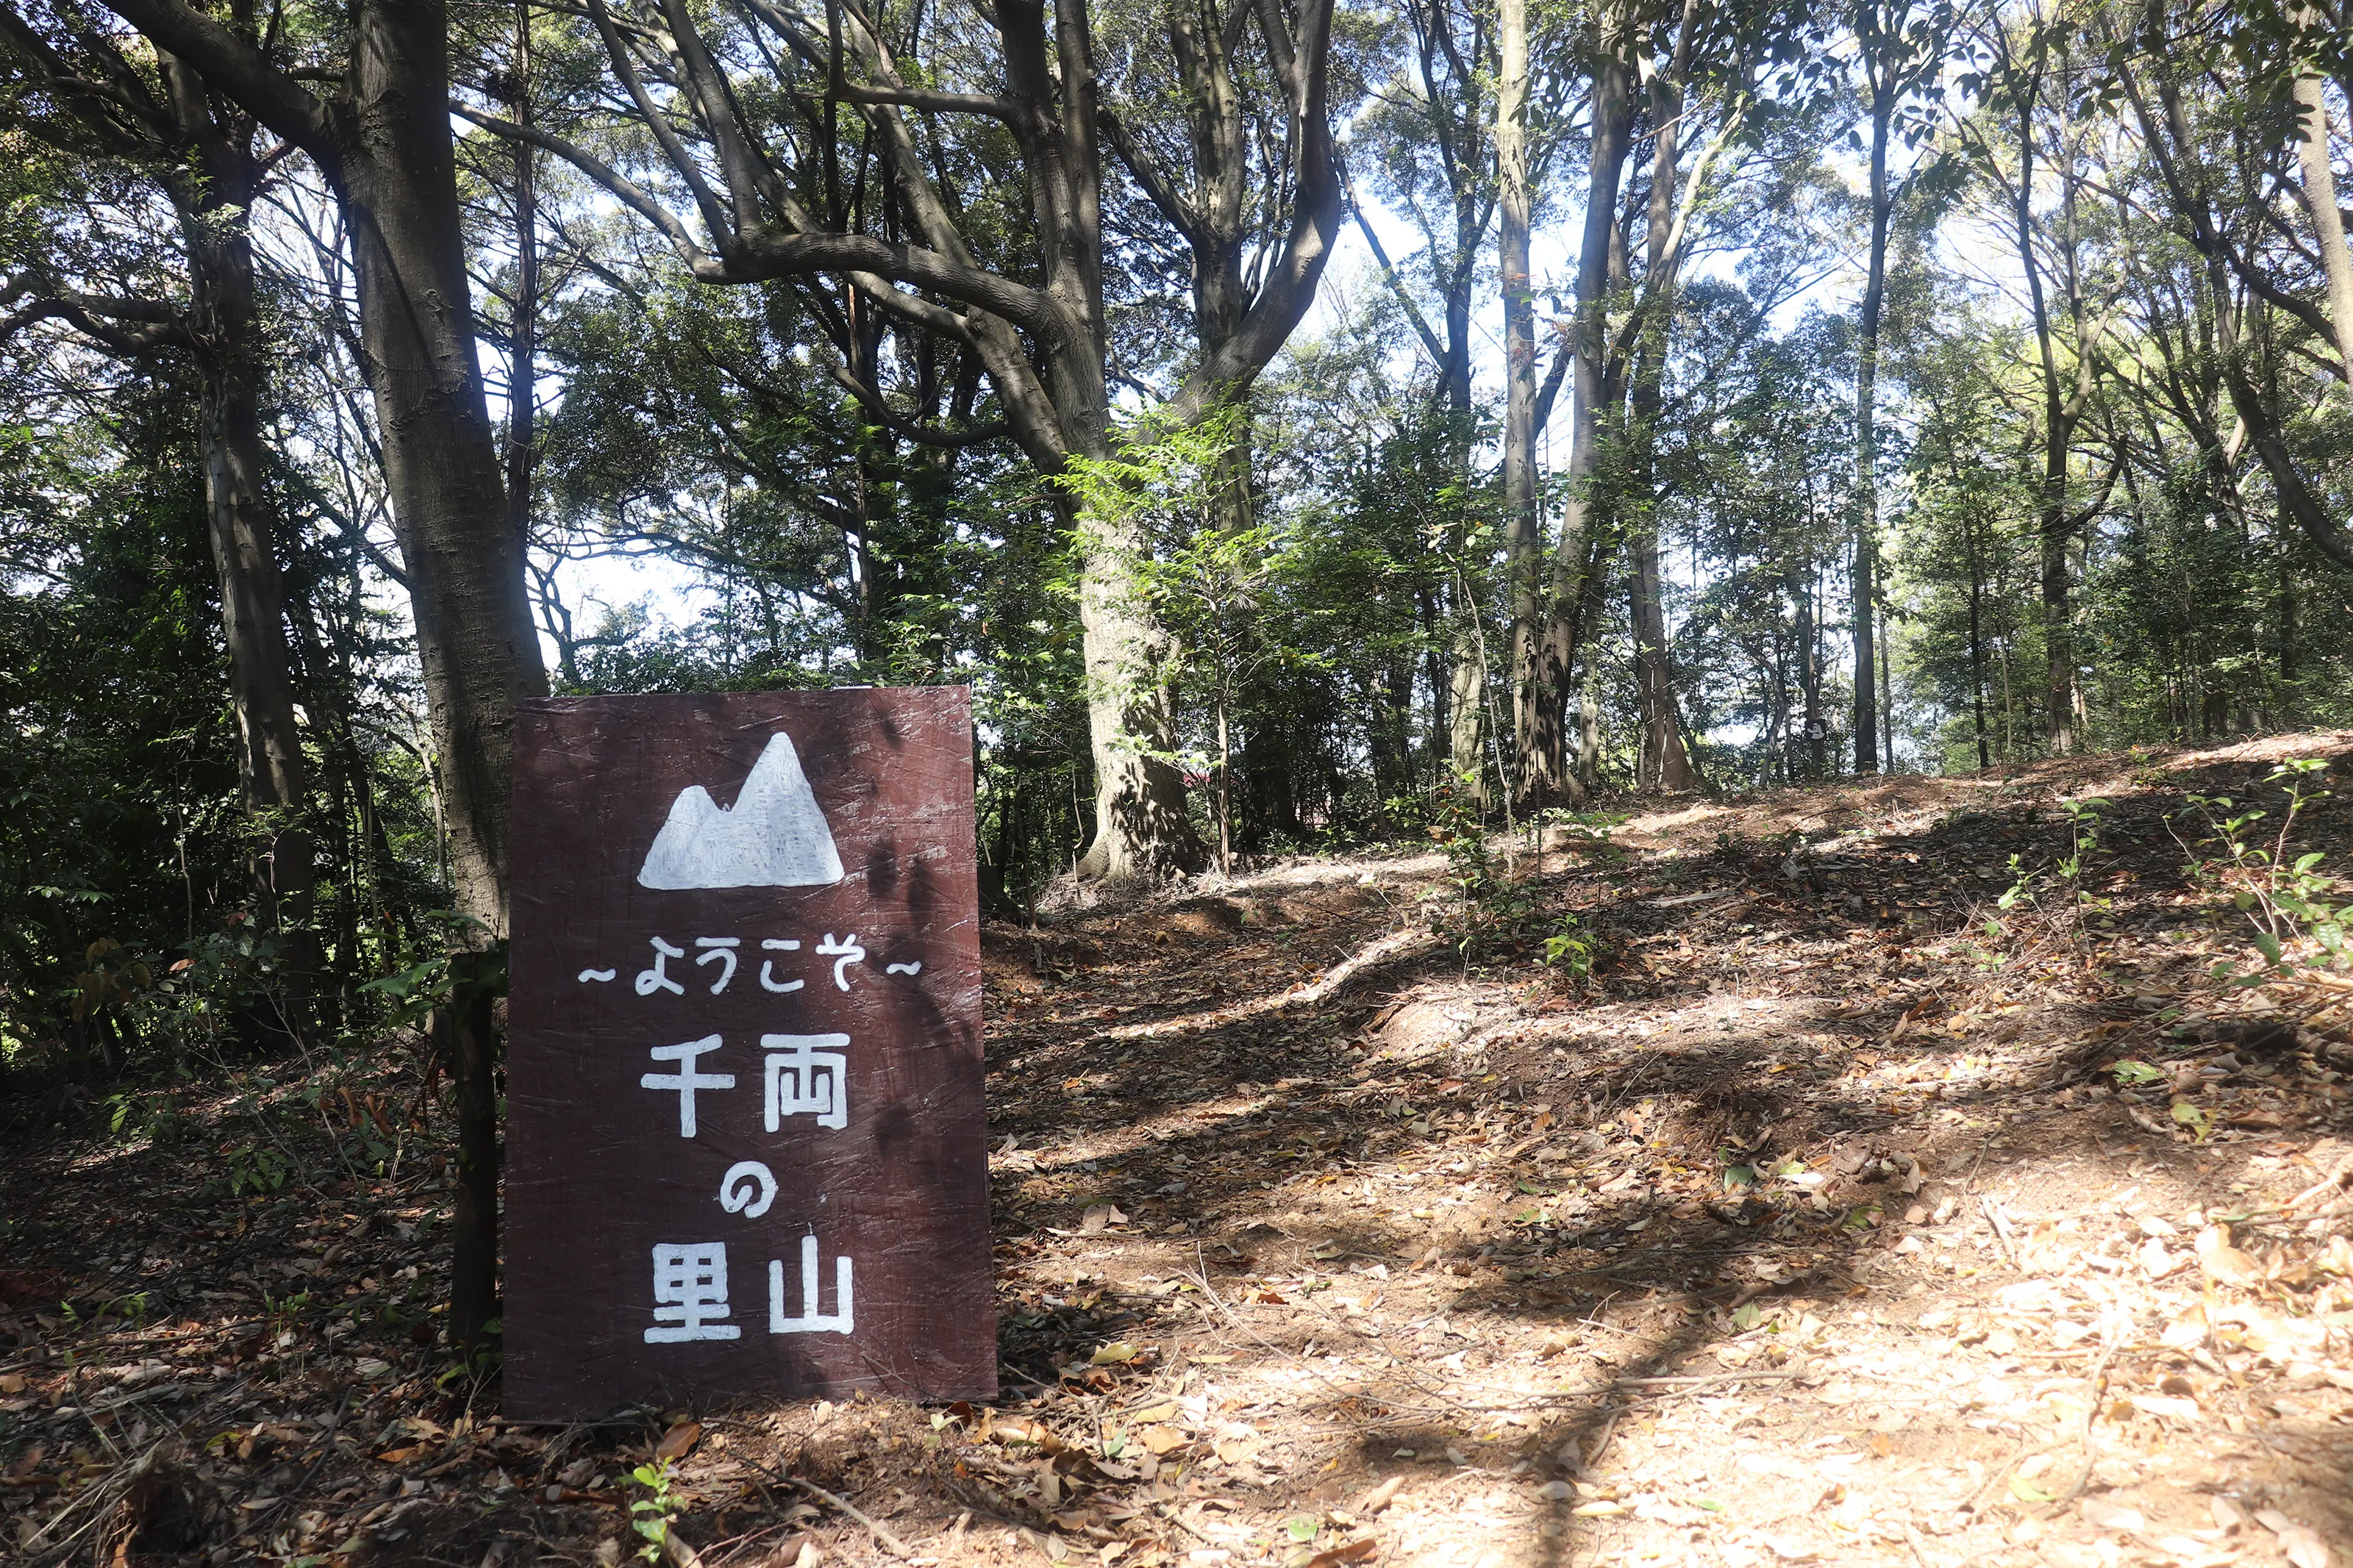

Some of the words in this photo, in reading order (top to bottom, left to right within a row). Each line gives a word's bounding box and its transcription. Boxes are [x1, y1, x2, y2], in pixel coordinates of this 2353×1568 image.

[640, 1031, 851, 1138] 千両
[718, 1159, 779, 1220] の
[643, 1234, 856, 1344] 里山
